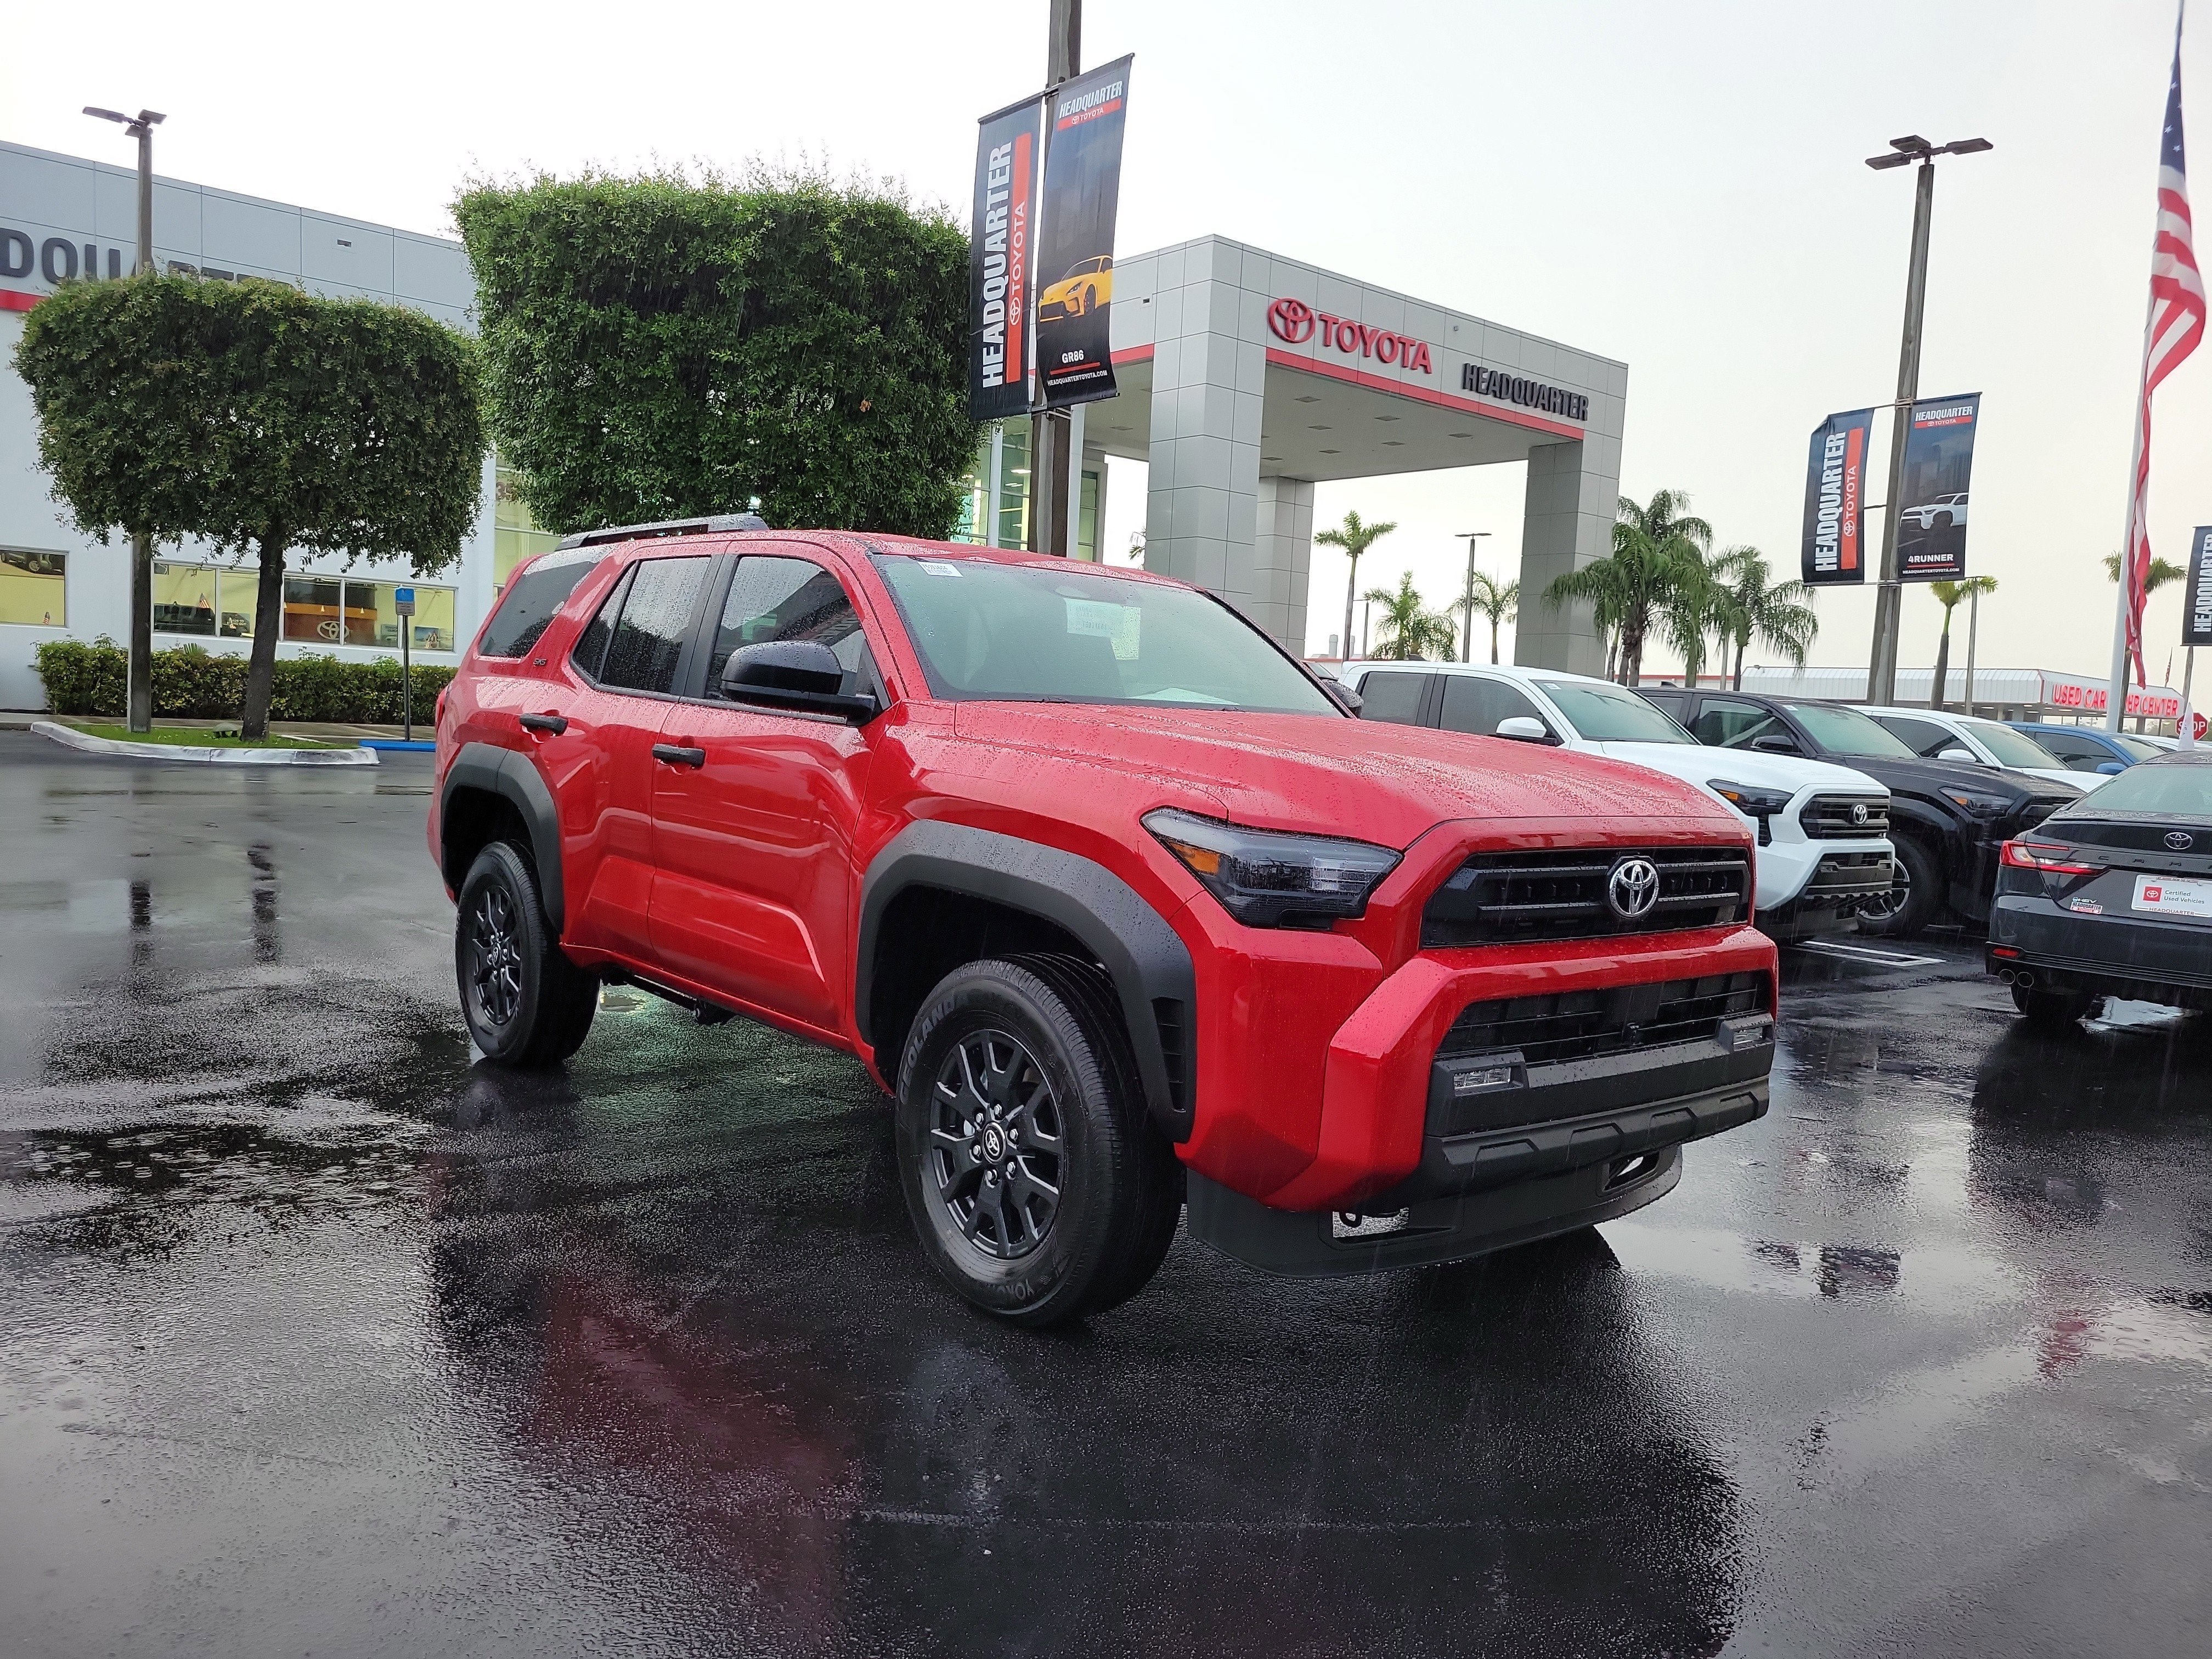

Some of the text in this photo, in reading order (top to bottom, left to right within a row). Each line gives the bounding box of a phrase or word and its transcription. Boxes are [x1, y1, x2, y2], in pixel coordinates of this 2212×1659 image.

[1059, 81, 1123, 119] HEADQUARTER
[1080, 108, 1104, 121] TOYOTA
[1012, 201, 1026, 296] TOYOTA
[982, 140, 1012, 388] HEADQUARTER
[1319, 313, 1432, 374] TOYOTA
[1062, 350, 1084, 364] GR86
[1047, 370, 1107, 386] HEADQUARTERTOYOTA.COM
[1462, 363, 1589, 421] HEADQUARTER
[1915, 406, 1973, 422] HEADQUARTER
[1815, 431, 1846, 572] HEADQUARTER
[1844, 465, 1857, 519] TOYOTA
[1908, 554, 1954, 563] 4RUNNER
[2052, 682, 2084, 706] USED
[2084, 687, 2108, 710] CAR
[2141, 695, 2178, 715] CENTER
[2177, 721, 2205, 732] SOP
[2149, 907, 2194, 916] HEADQUARTER
